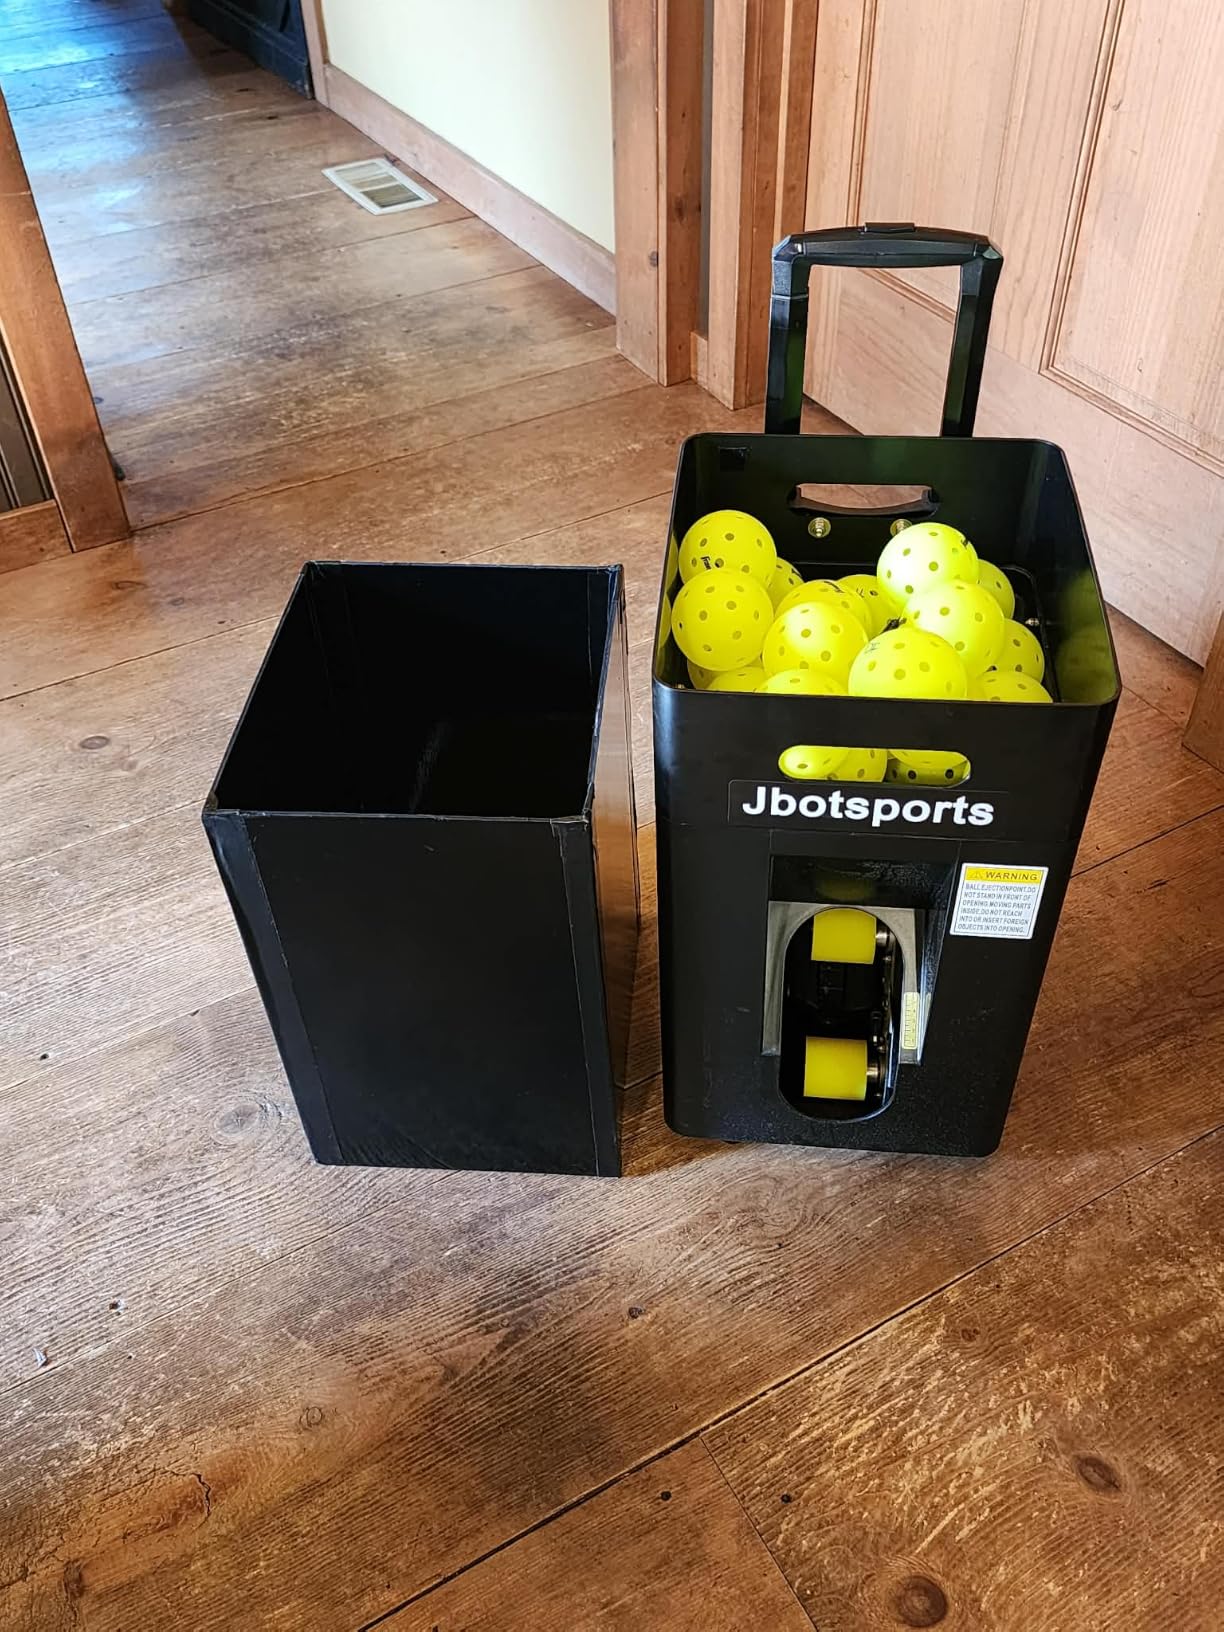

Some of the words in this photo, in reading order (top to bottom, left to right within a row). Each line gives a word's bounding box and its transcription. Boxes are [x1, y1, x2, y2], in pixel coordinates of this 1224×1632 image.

[742, 786, 995, 827] Jbotsports
[985, 871, 1037, 881] WARNING
[1003, 917, 1028, 925] FOREIGN
